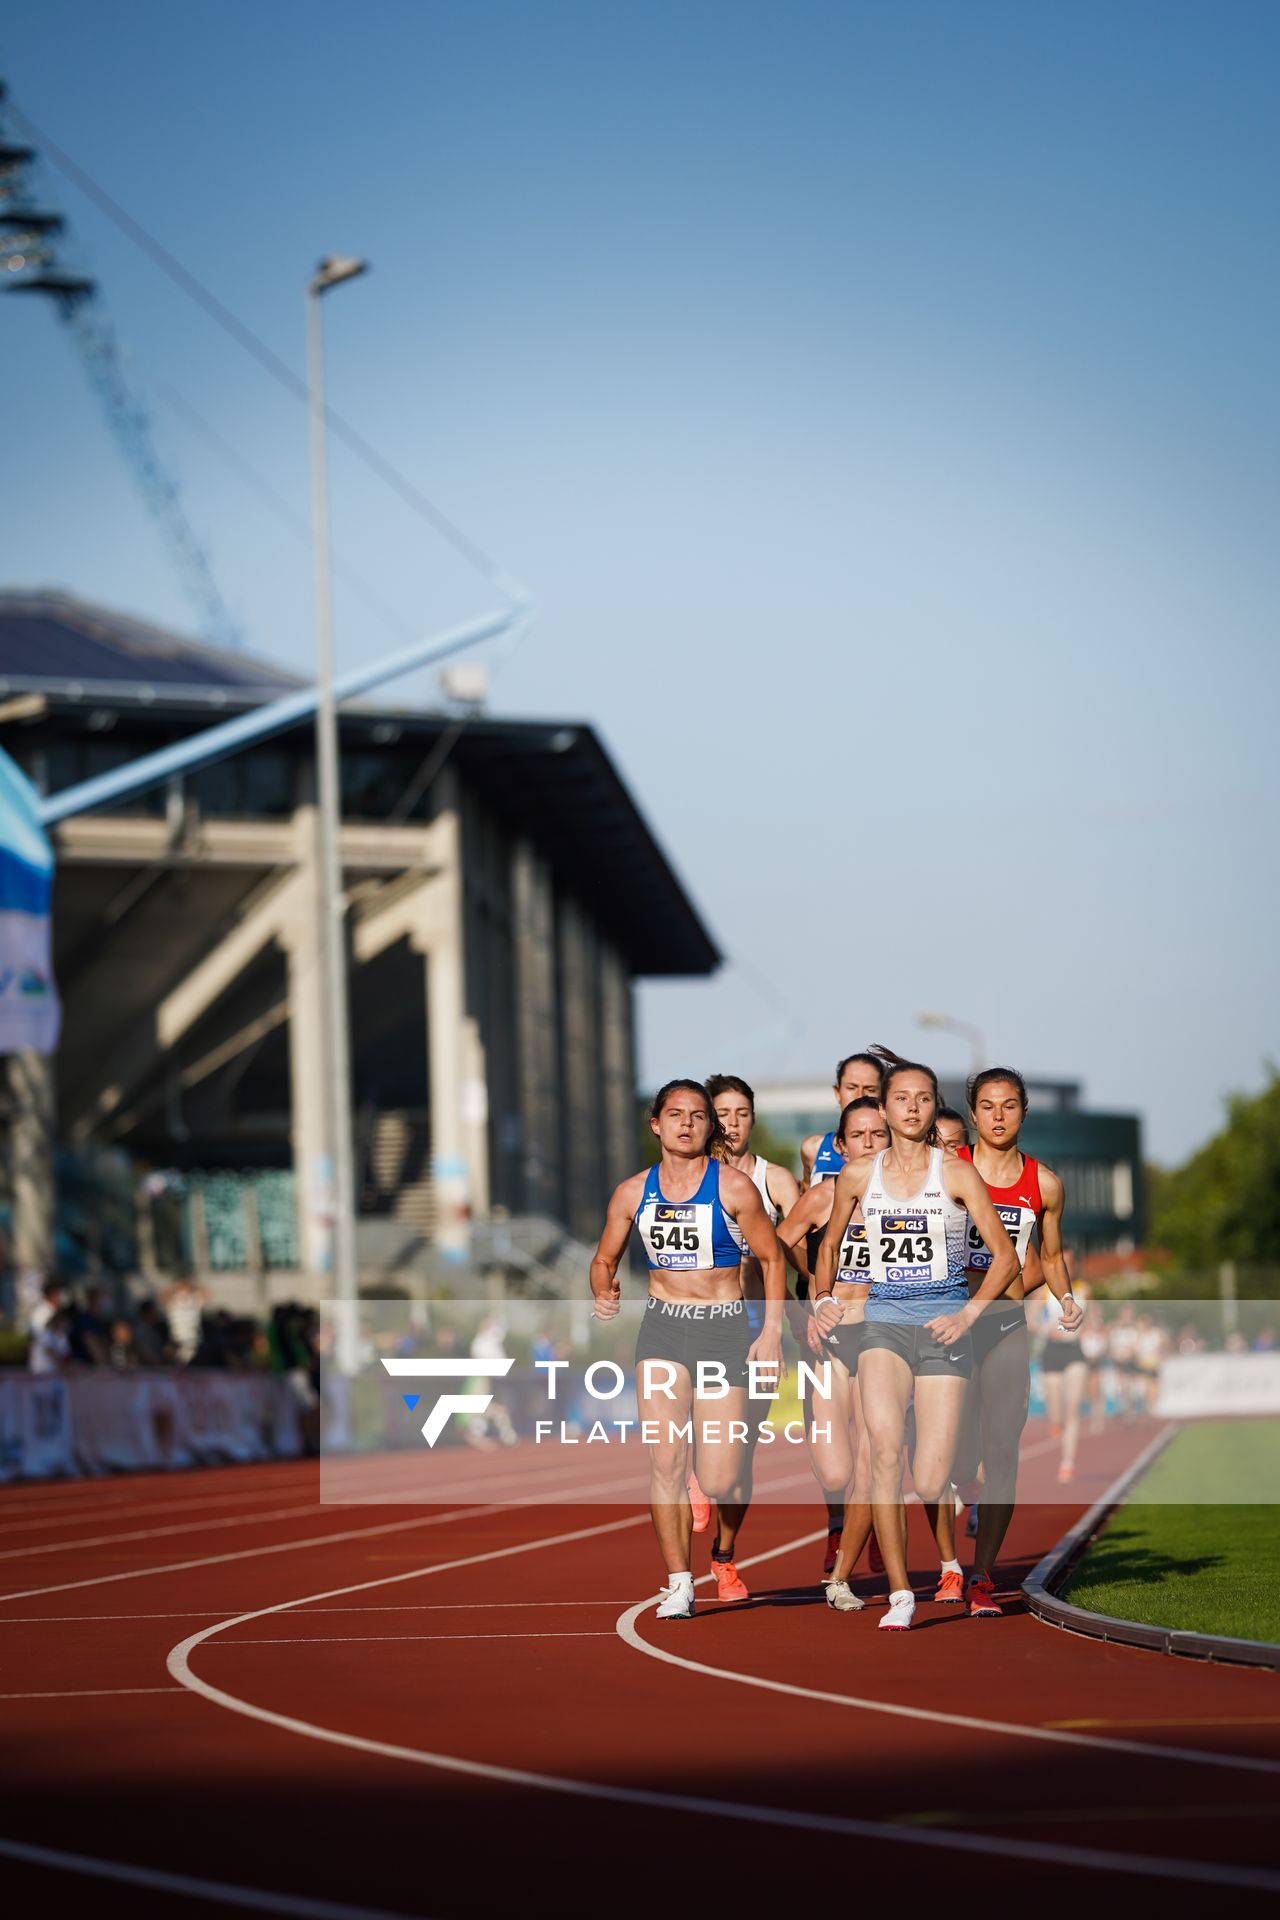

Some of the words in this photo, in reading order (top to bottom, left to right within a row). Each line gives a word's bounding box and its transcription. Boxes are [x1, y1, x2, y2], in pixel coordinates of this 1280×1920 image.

[674, 1210, 693, 1219] GLS
[1000, 1211, 1018, 1222] GLS
[905, 1220, 924, 1231] GLS
[650, 1226, 699, 1251] 545
[880, 1236, 933, 1263] 243
[671, 1256, 696, 1264] PLAN
[904, 1268, 930, 1277] PLAN
[661, 1303, 706, 1319] NIKE
[710, 1299, 743, 1319] PRO
